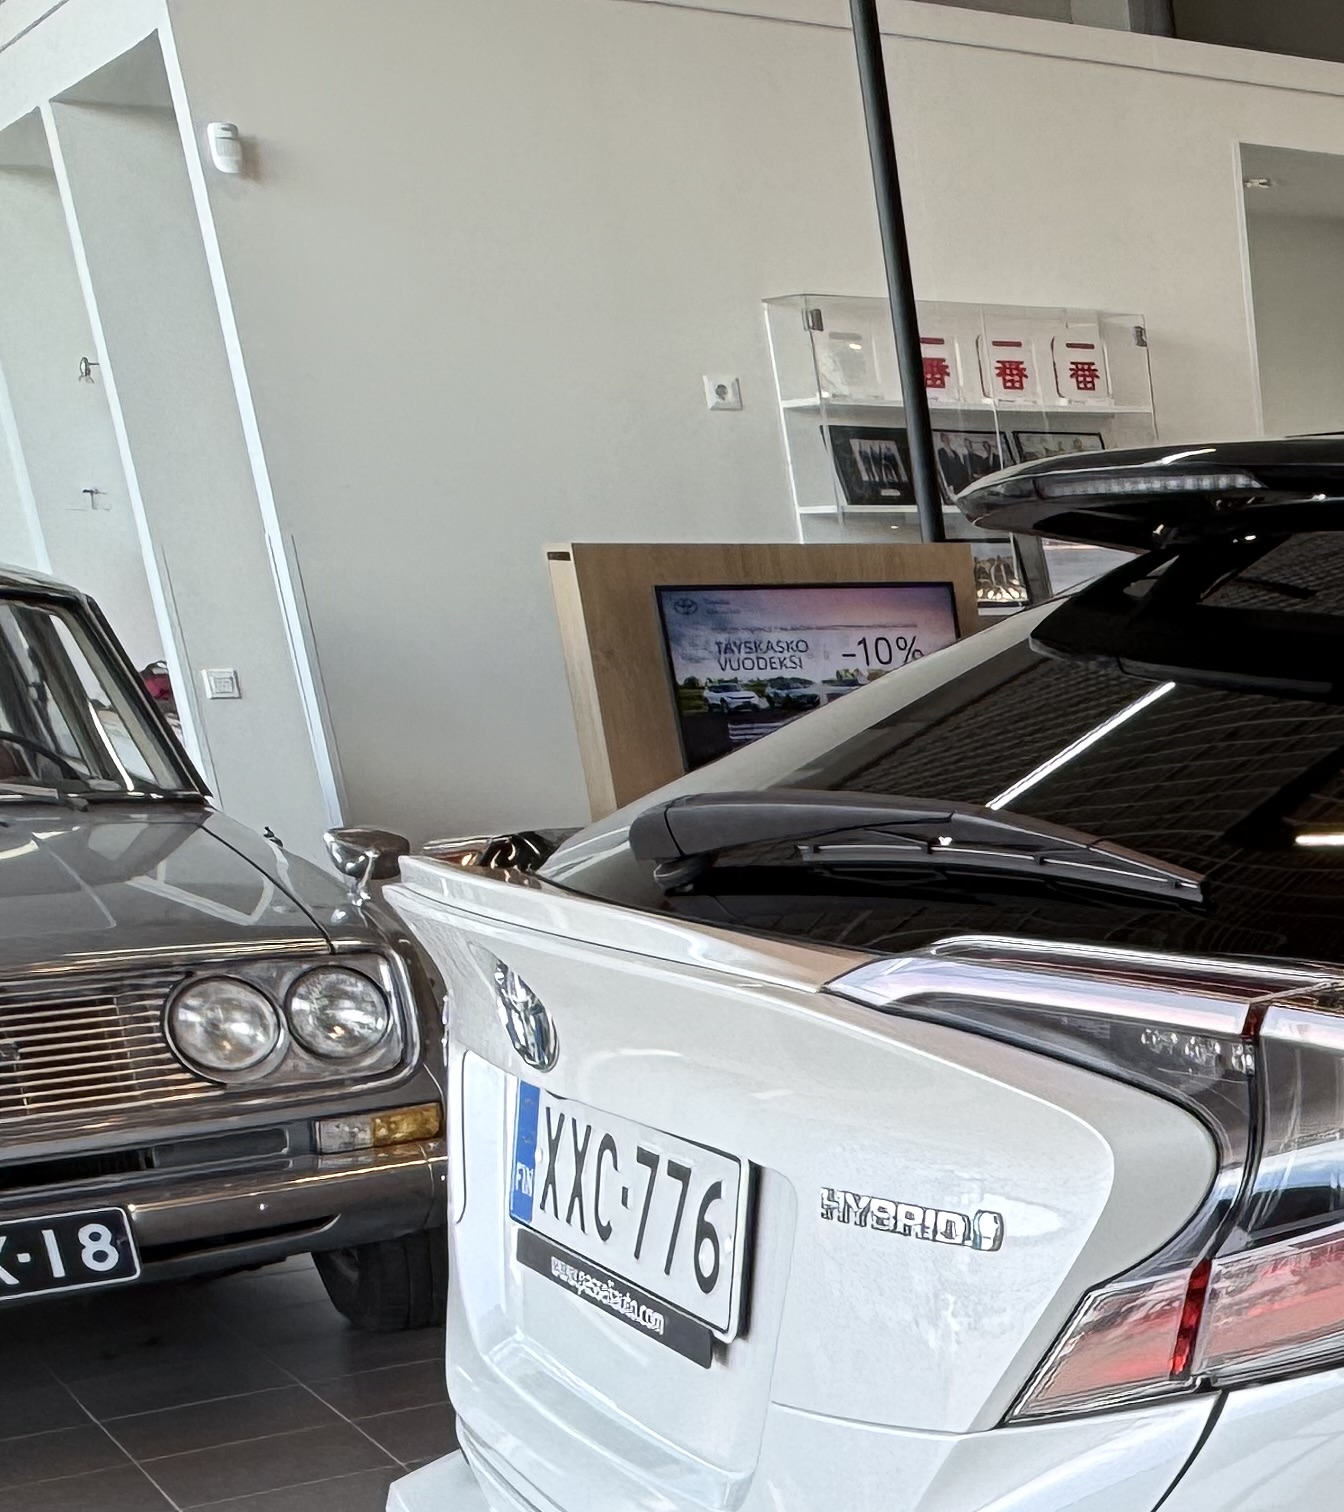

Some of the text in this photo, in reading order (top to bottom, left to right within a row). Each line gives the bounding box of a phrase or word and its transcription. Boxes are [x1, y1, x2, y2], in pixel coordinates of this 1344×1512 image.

[717, 656, 804, 672] VUODEKSI
[841, 635, 925, 667] -10%
[515, 1161, 534, 1198] FIN
[539, 1105, 723, 1295] XXC-776
[820, 1186, 973, 1247] HYBRID
